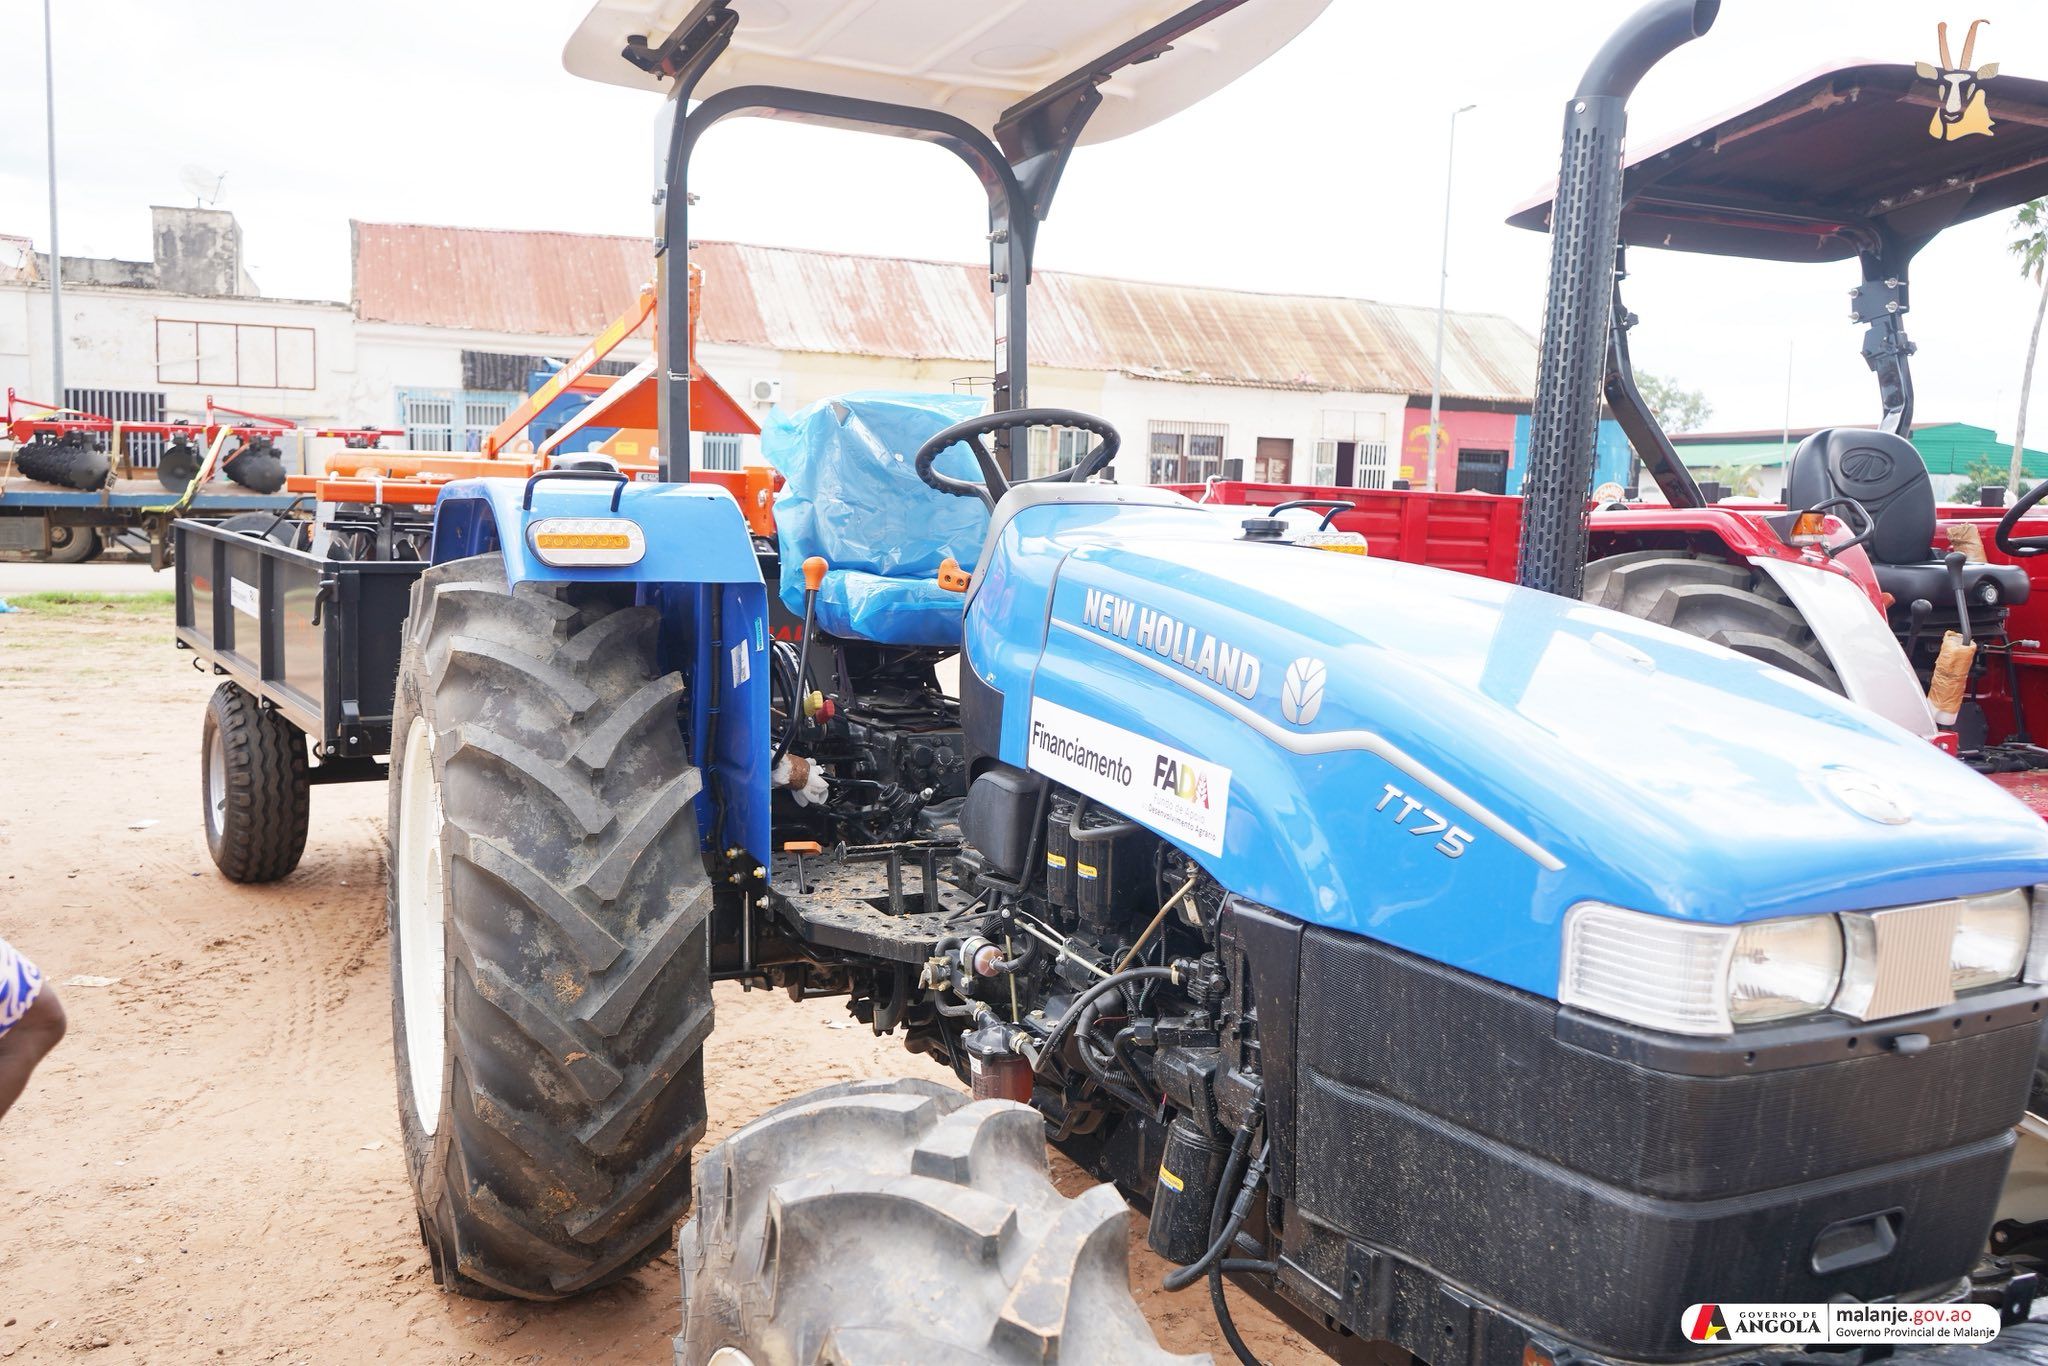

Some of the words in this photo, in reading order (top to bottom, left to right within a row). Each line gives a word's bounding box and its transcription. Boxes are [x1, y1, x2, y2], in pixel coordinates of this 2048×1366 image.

[1083, 588, 1135, 640] NEW
[1136, 607, 1261, 700] HOLLAND
[1032, 721, 1132, 787] Financiamento
[1375, 783, 1475, 859] TT75
